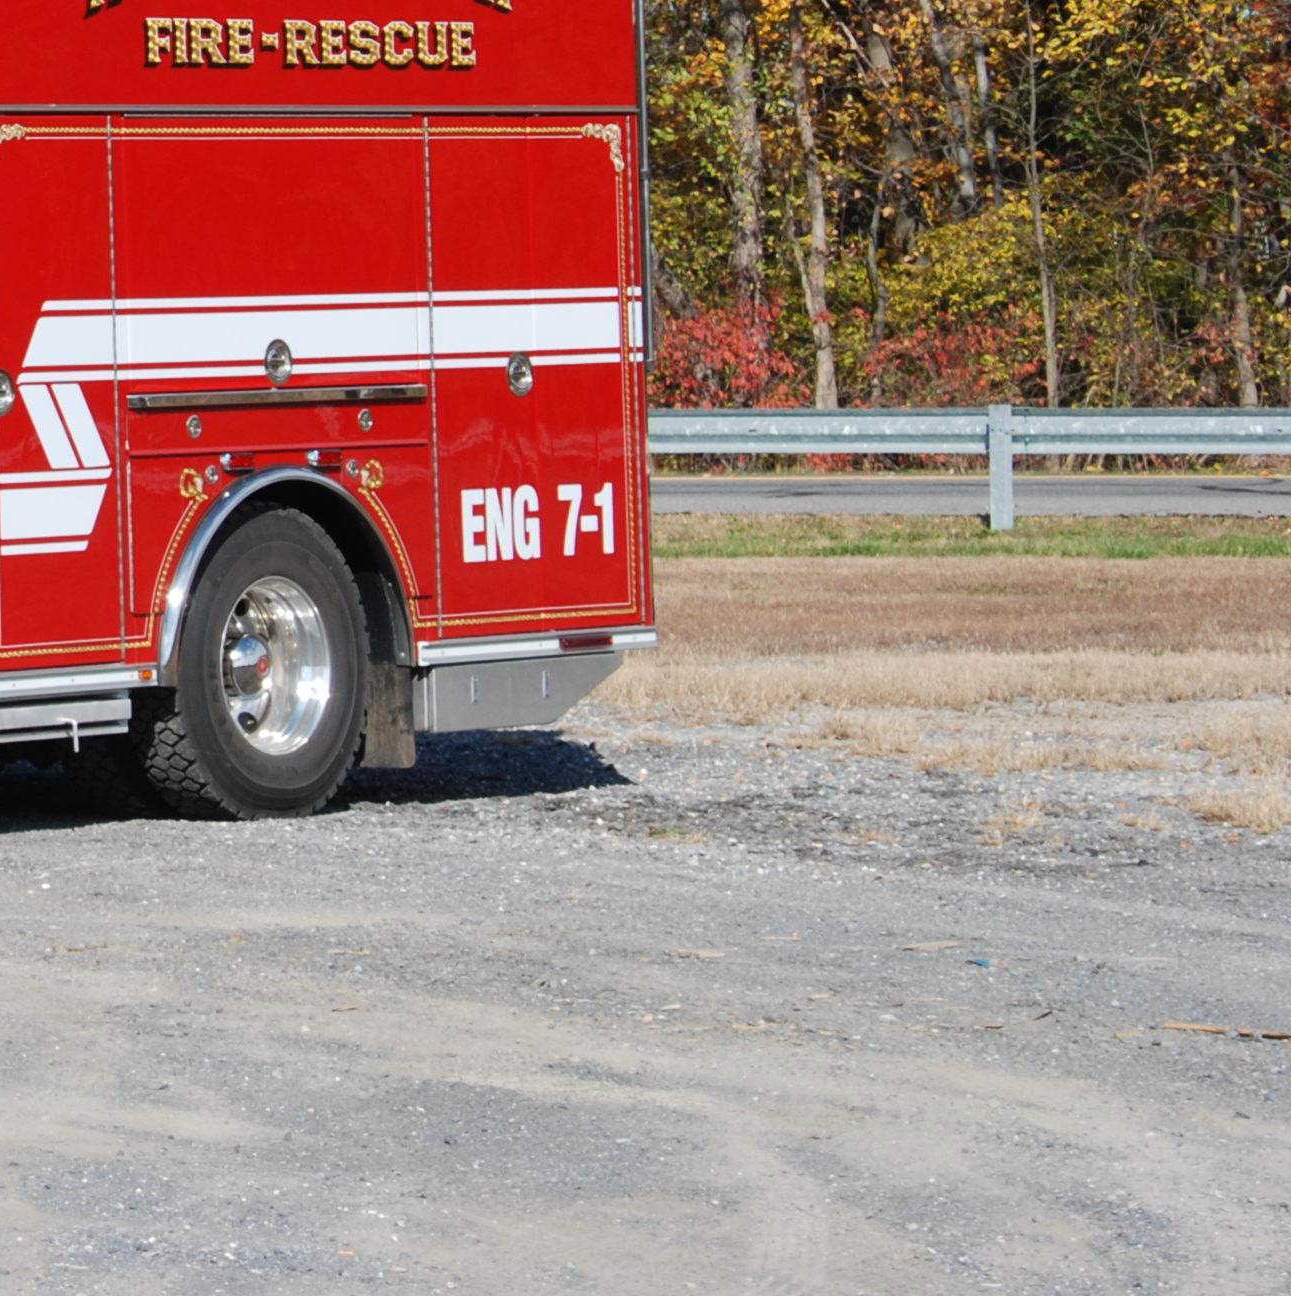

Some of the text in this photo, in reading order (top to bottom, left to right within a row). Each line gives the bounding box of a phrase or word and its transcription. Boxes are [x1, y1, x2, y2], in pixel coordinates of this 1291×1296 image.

[145, 17, 476, 68] FIRE-RESCUE
[460, 482, 615, 563] ENG 7-1
